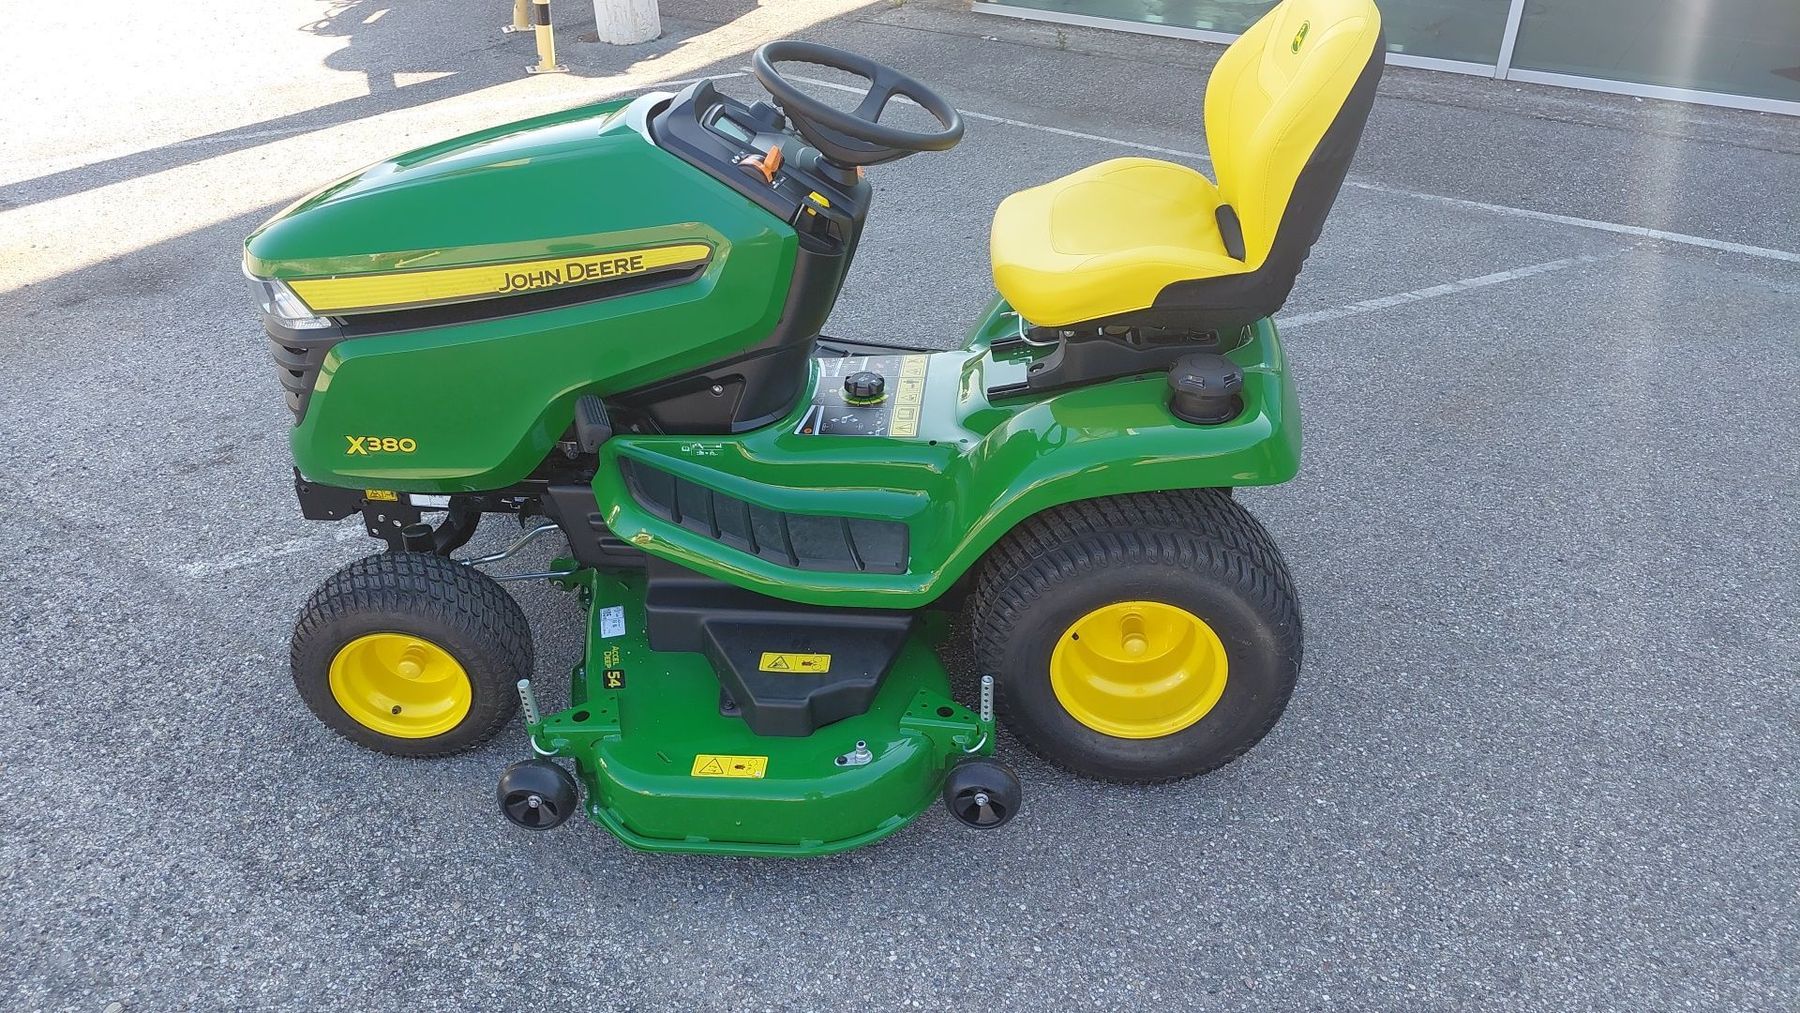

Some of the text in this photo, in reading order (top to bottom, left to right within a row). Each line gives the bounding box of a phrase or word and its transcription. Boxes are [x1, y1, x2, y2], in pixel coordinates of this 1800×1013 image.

[498, 255, 644, 292] JOHN DEERE
[345, 435, 417, 455] X380
[604, 652, 612, 669] DEEP
[612, 646, 620, 666] ACCEL
[607, 671, 621, 688] 54
